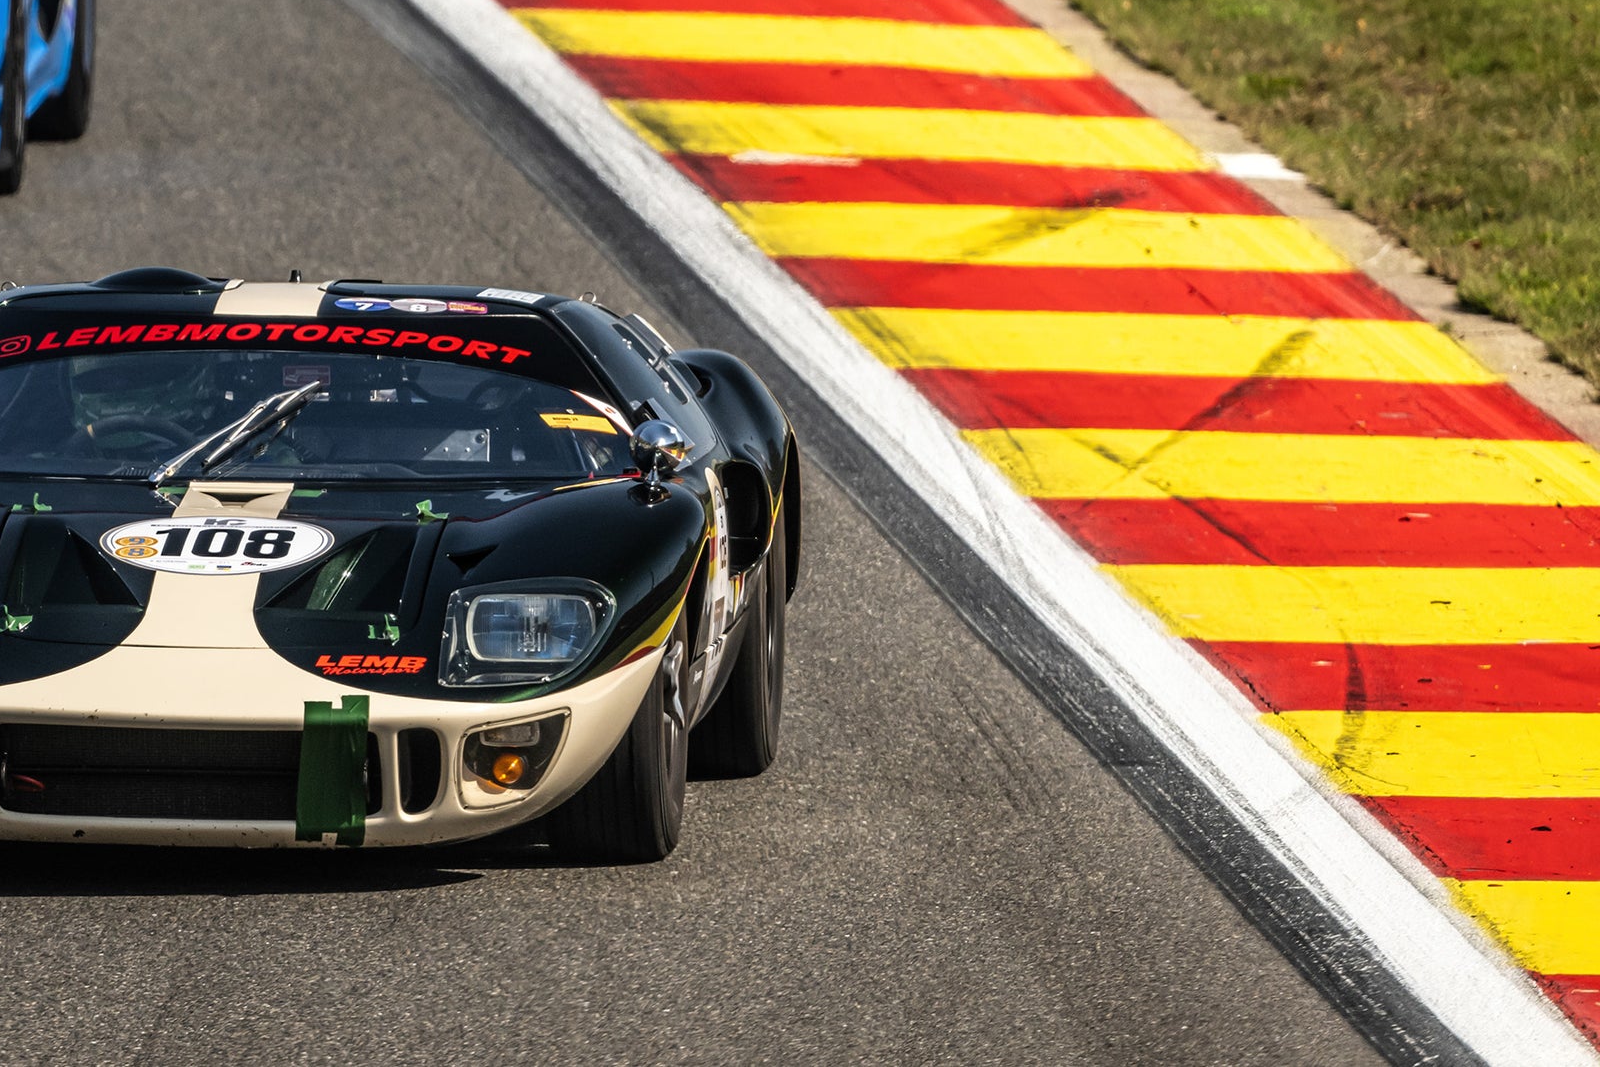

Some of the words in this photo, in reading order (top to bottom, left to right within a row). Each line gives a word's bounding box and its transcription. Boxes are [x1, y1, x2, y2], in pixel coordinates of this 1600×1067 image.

[36, 324, 532, 364] LEMBMOTORSPORT
[155, 528, 296, 559] 108
[315, 655, 428, 668] LEMB
[322, 666, 421, 675] Motorsport
